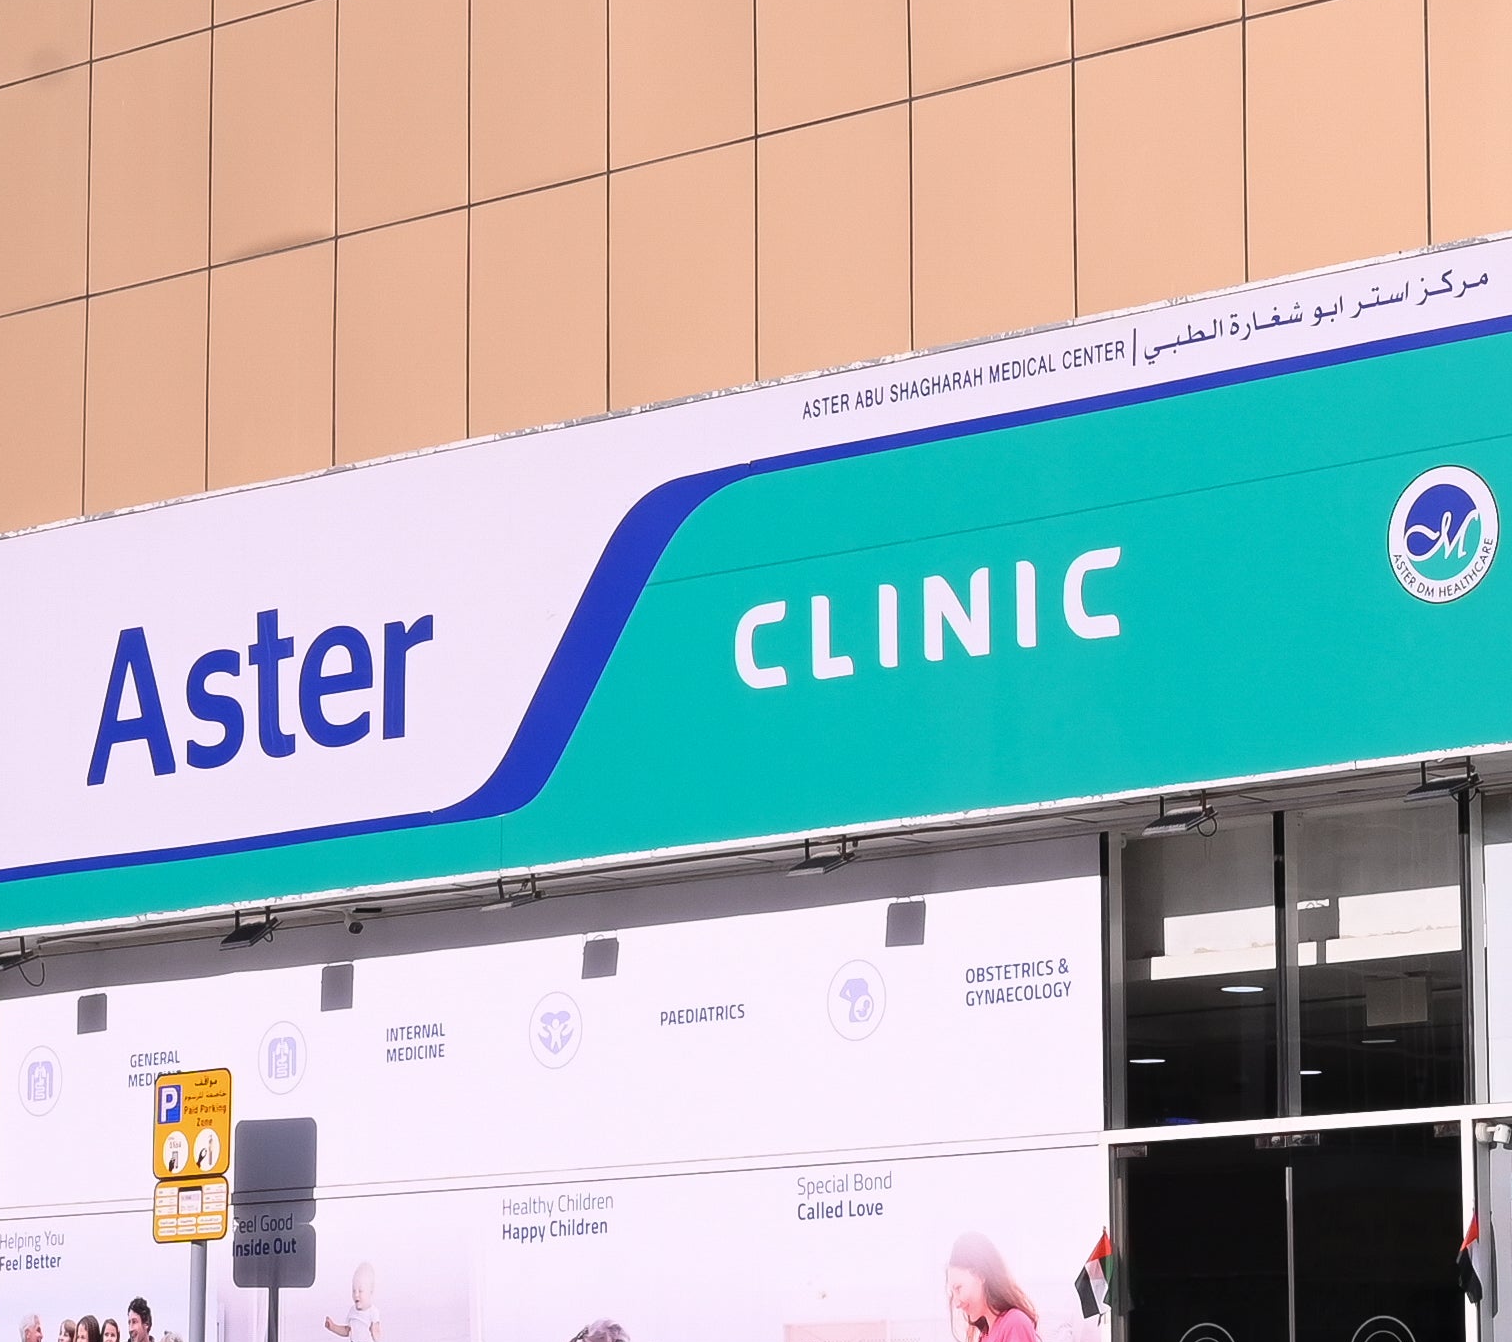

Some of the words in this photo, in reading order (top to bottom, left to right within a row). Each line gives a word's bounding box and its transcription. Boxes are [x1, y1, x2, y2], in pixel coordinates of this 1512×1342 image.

[1351, 280, 1409, 319] استر
[1415, 269, 1489, 306] مركز
[1229, 302, 1303, 341] شغارة
[1311, 296, 1343, 327] ابو
[1143, 319, 1223, 365] الطبي
[802, 393, 850, 420] ASTER
[855, 386, 884, 410] ABU
[890, 367, 983, 403] SHAGHARAH
[989, 355, 1056, 382] MEDICAL
[1062, 340, 1125, 370] CENTER
[1393, 554, 1417, 588] ASTER
[1416, 582, 1434, 598] DM
[1438, 538, 1494, 598] HEALTHCARE
[734, 546, 1121, 690] CLINIC
[87, 608, 434, 786] Aster
[964, 960, 1054, 985] OBSTETRICS
[1057, 957, 1070, 975] &
[964, 980, 1072, 1008] GYNAECOLOGY
[659, 1003, 746, 1027] PAEDIATRICS
[386, 1022, 446, 1043] INTERNAL
[130, 1050, 180, 1068] GENERAL
[385, 1042, 446, 1063] MEDICINE
[160, 1088, 178, 1123] P
[200, 1104, 227, 1115] Parking
[797, 1173, 851, 1199] Special
[854, 1170, 893, 1193] Bond
[502, 1196, 555, 1218] Healthy
[557, 1191, 614, 1215] Children
[797, 1199, 844, 1221] Called
[848, 1198, 884, 1218] Love
[260, 1213, 293, 1232] Good
[502, 1220, 546, 1244] Happy
[549, 1216, 608, 1238] Children
[0, 1231, 41, 1252] Helping
[44, 1230, 65, 1246] You
[232, 1239, 270, 1257] Inside
[273, 1238, 297, 1255] Out
[0, 1255, 22, 1271] Feel
[25, 1254, 61, 1270] Better
